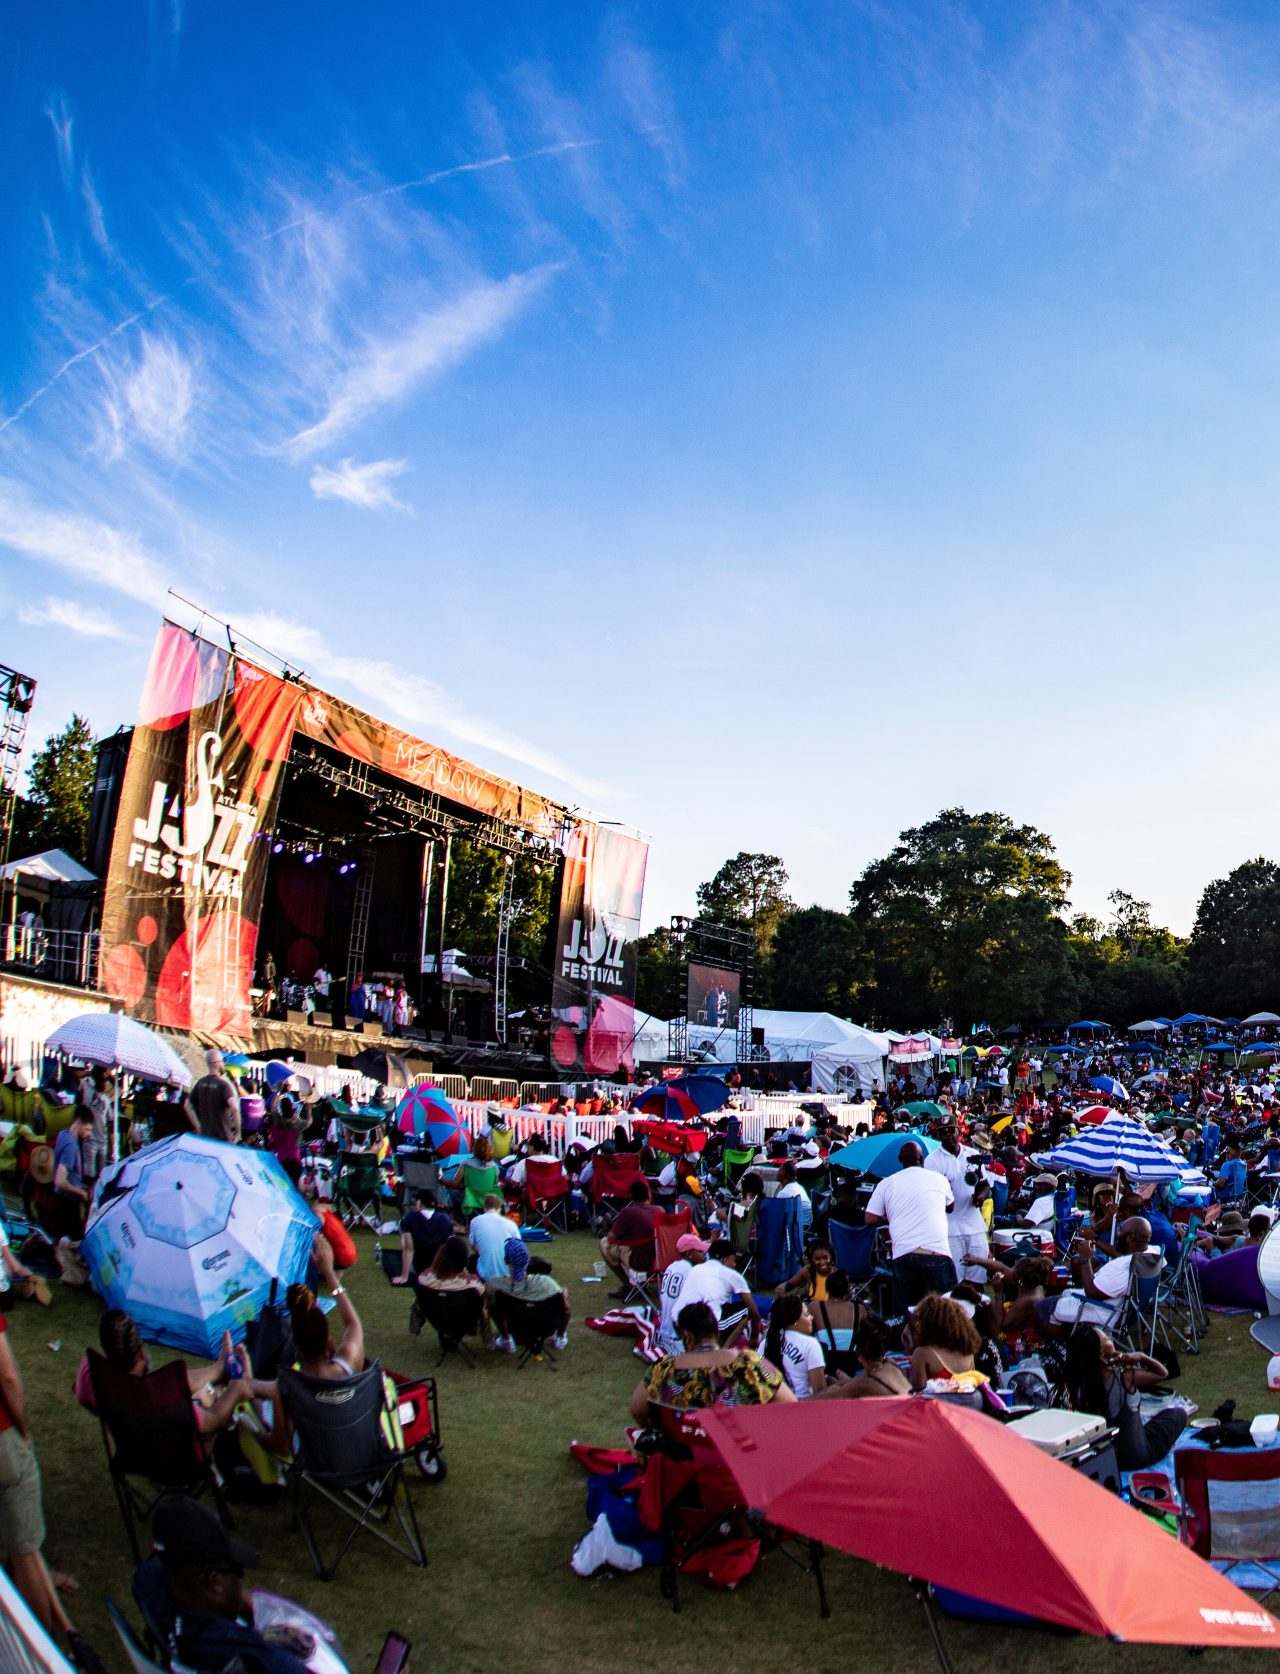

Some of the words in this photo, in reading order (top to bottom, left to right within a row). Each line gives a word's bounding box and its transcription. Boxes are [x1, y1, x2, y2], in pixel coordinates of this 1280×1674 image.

[395, 741, 486, 801] MEADOW
[128, 843, 243, 899] FESTIVAL
[561, 962, 623, 986] FESTIVAL
